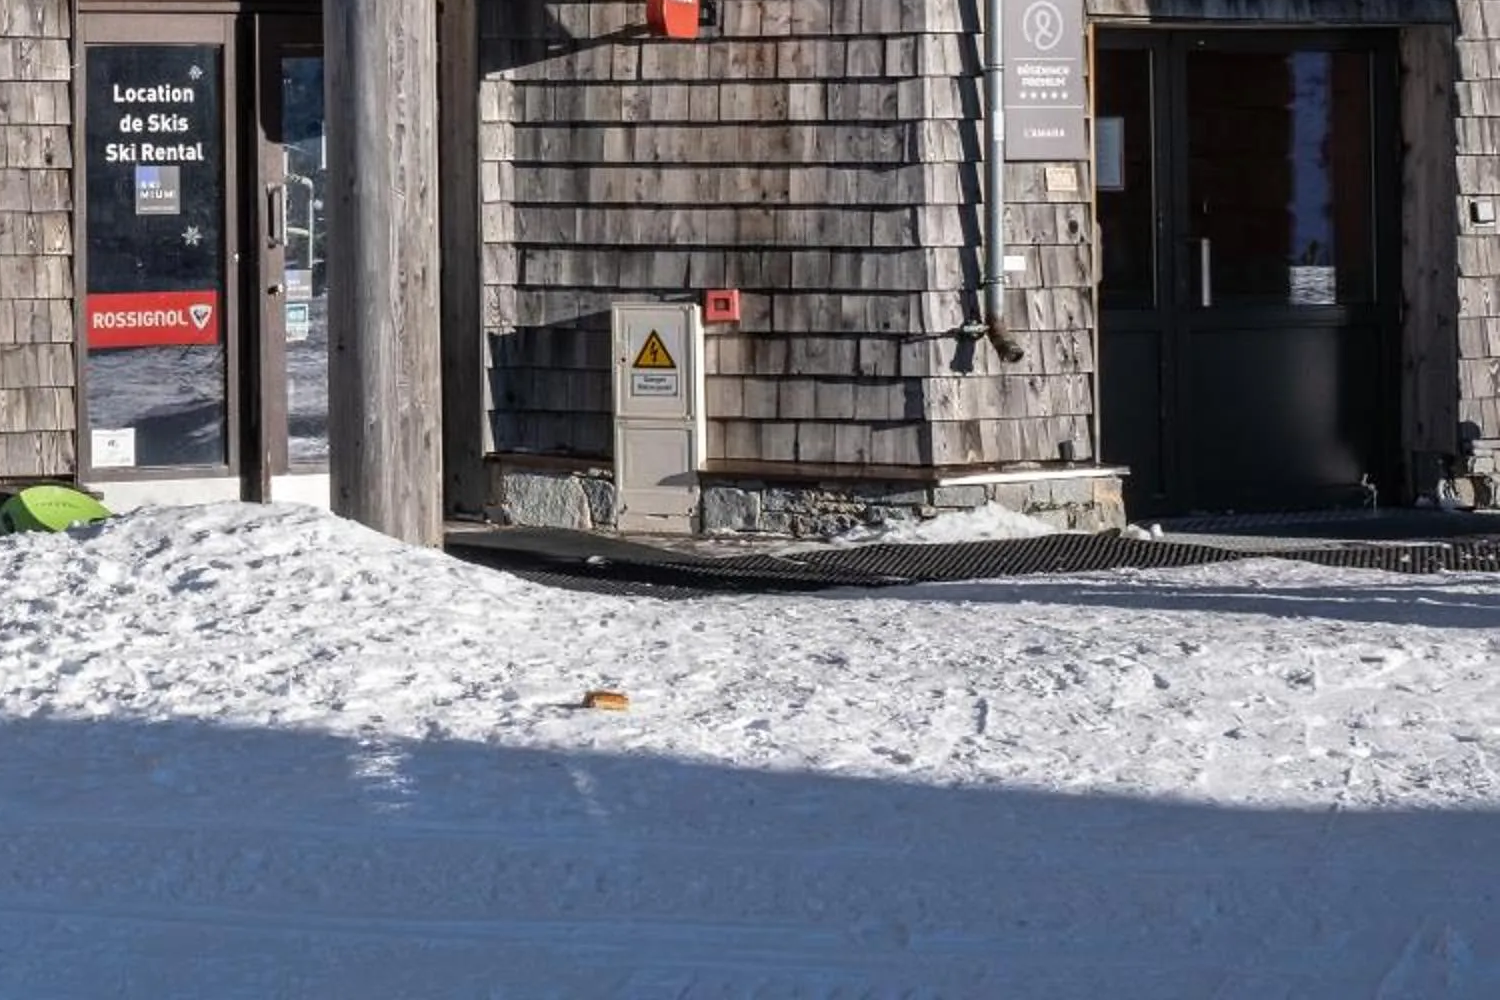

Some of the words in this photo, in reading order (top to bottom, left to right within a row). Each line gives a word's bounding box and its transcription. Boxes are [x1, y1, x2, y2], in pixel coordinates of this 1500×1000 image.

[113, 85, 194, 102] Location
[119, 114, 143, 132] de
[147, 114, 188, 132] Skis
[105, 144, 136, 161] Ski
[141, 143, 204, 161] Rental
[92, 310, 188, 330] ROSSIGNOL
